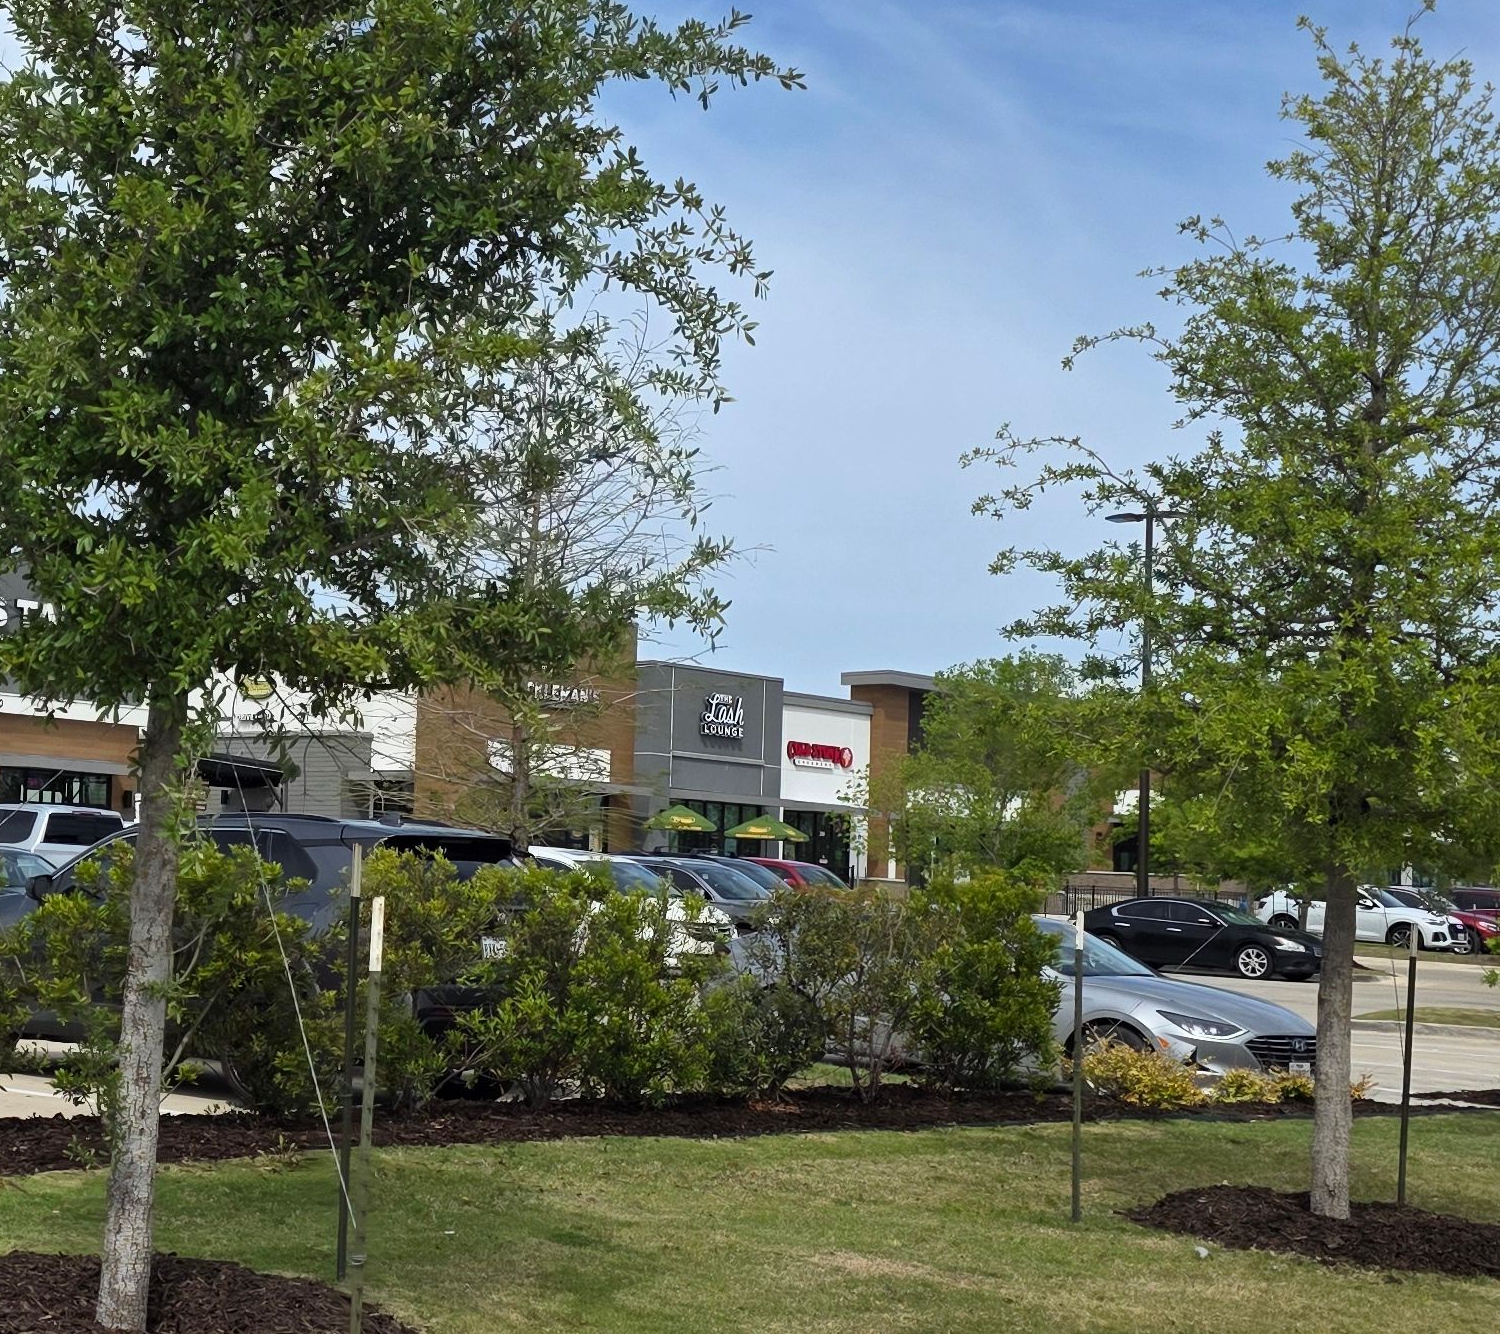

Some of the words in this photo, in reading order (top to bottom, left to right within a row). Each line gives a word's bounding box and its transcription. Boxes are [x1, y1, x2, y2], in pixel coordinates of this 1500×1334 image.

[16, 598, 66, 629] TA
[704, 693, 745, 726] Lash
[720, 694, 733, 704] THE
[704, 724, 744, 738] LOUNGE
